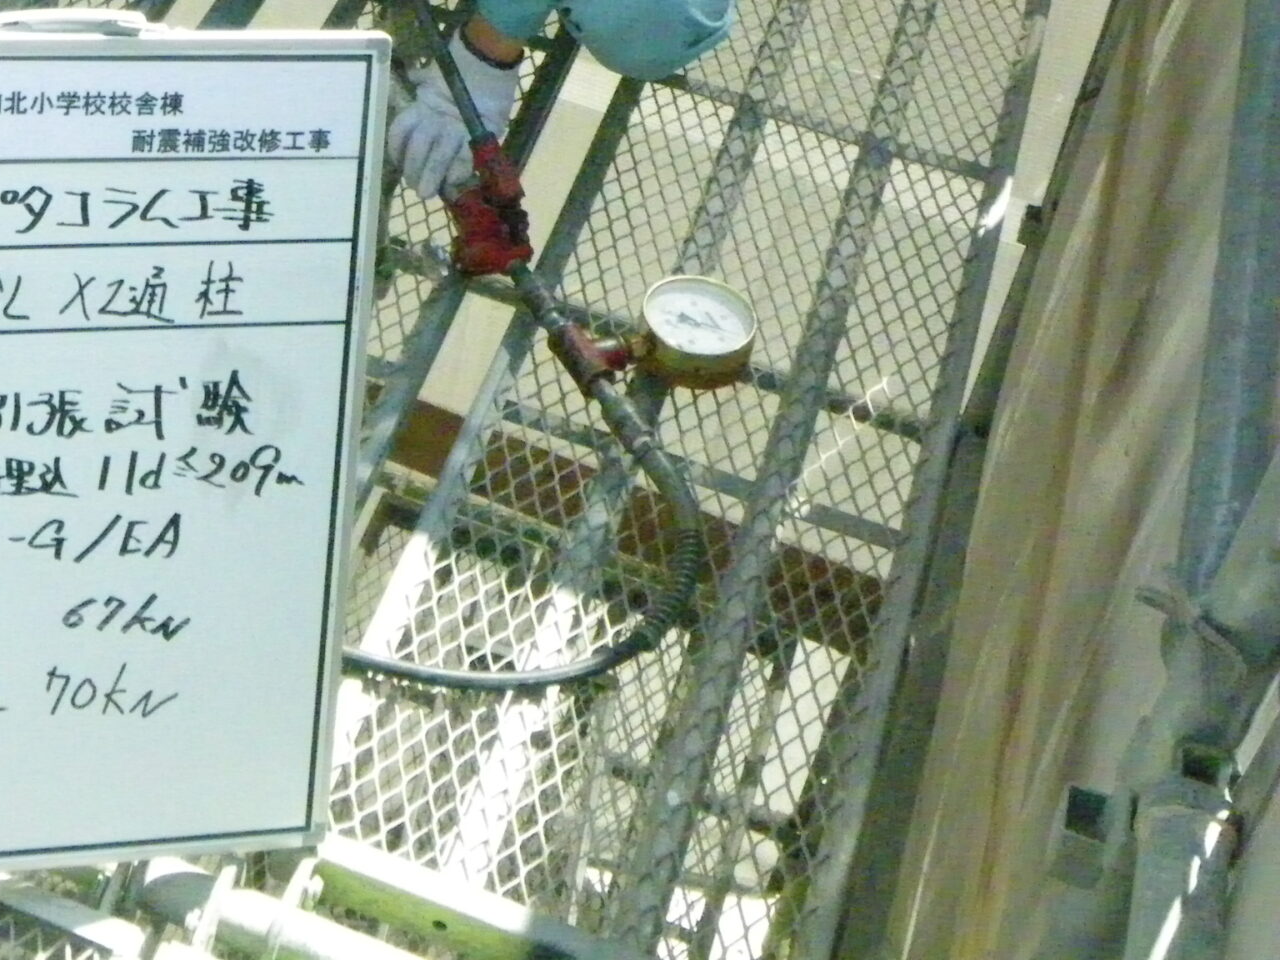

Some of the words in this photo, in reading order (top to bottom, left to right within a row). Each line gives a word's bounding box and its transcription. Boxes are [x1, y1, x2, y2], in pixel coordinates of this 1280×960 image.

[131, 127, 332, 155] 耐震補強改修工事
